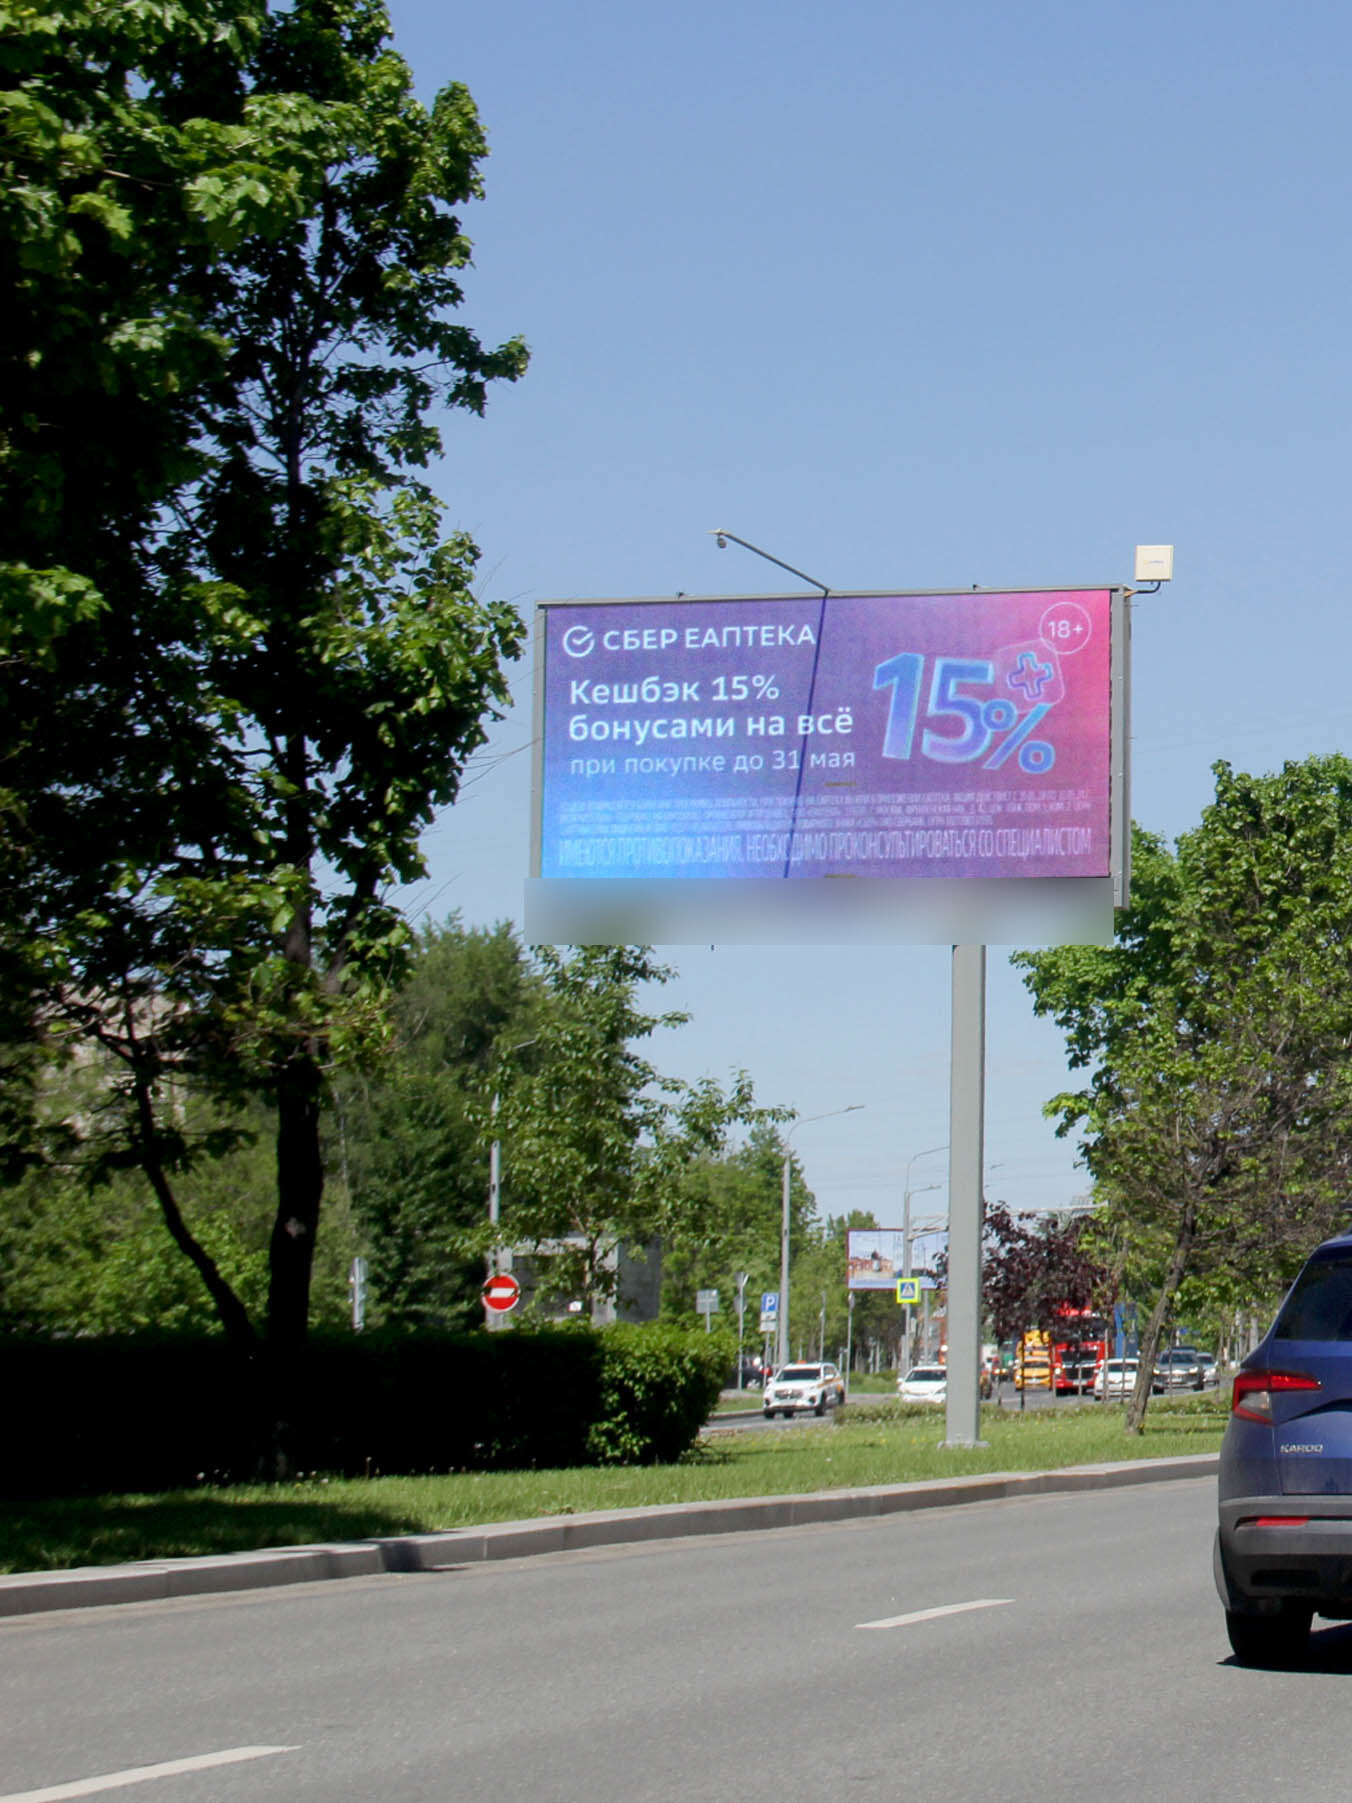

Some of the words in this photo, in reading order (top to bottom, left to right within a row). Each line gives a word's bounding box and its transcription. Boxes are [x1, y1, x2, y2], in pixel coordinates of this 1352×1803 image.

[603, 629, 678, 650] СБЕР
[685, 624, 817, 648] ЕАПТЕКА
[1048, 620, 1083, 638] 18+
[570, 676, 700, 704] Кешбэк
[711, 674, 780, 701] 15%
[568, 714, 735, 745] бонусами
[747, 715, 785, 736] на
[797, 707, 854, 735] всё
[872, 652, 1056, 774] 15%
[570, 757, 615, 778] при
[624, 754, 726, 777] покупке
[732, 753, 764, 773] до
[771, 750, 800, 769] 31
[810, 752, 855, 769] мая
